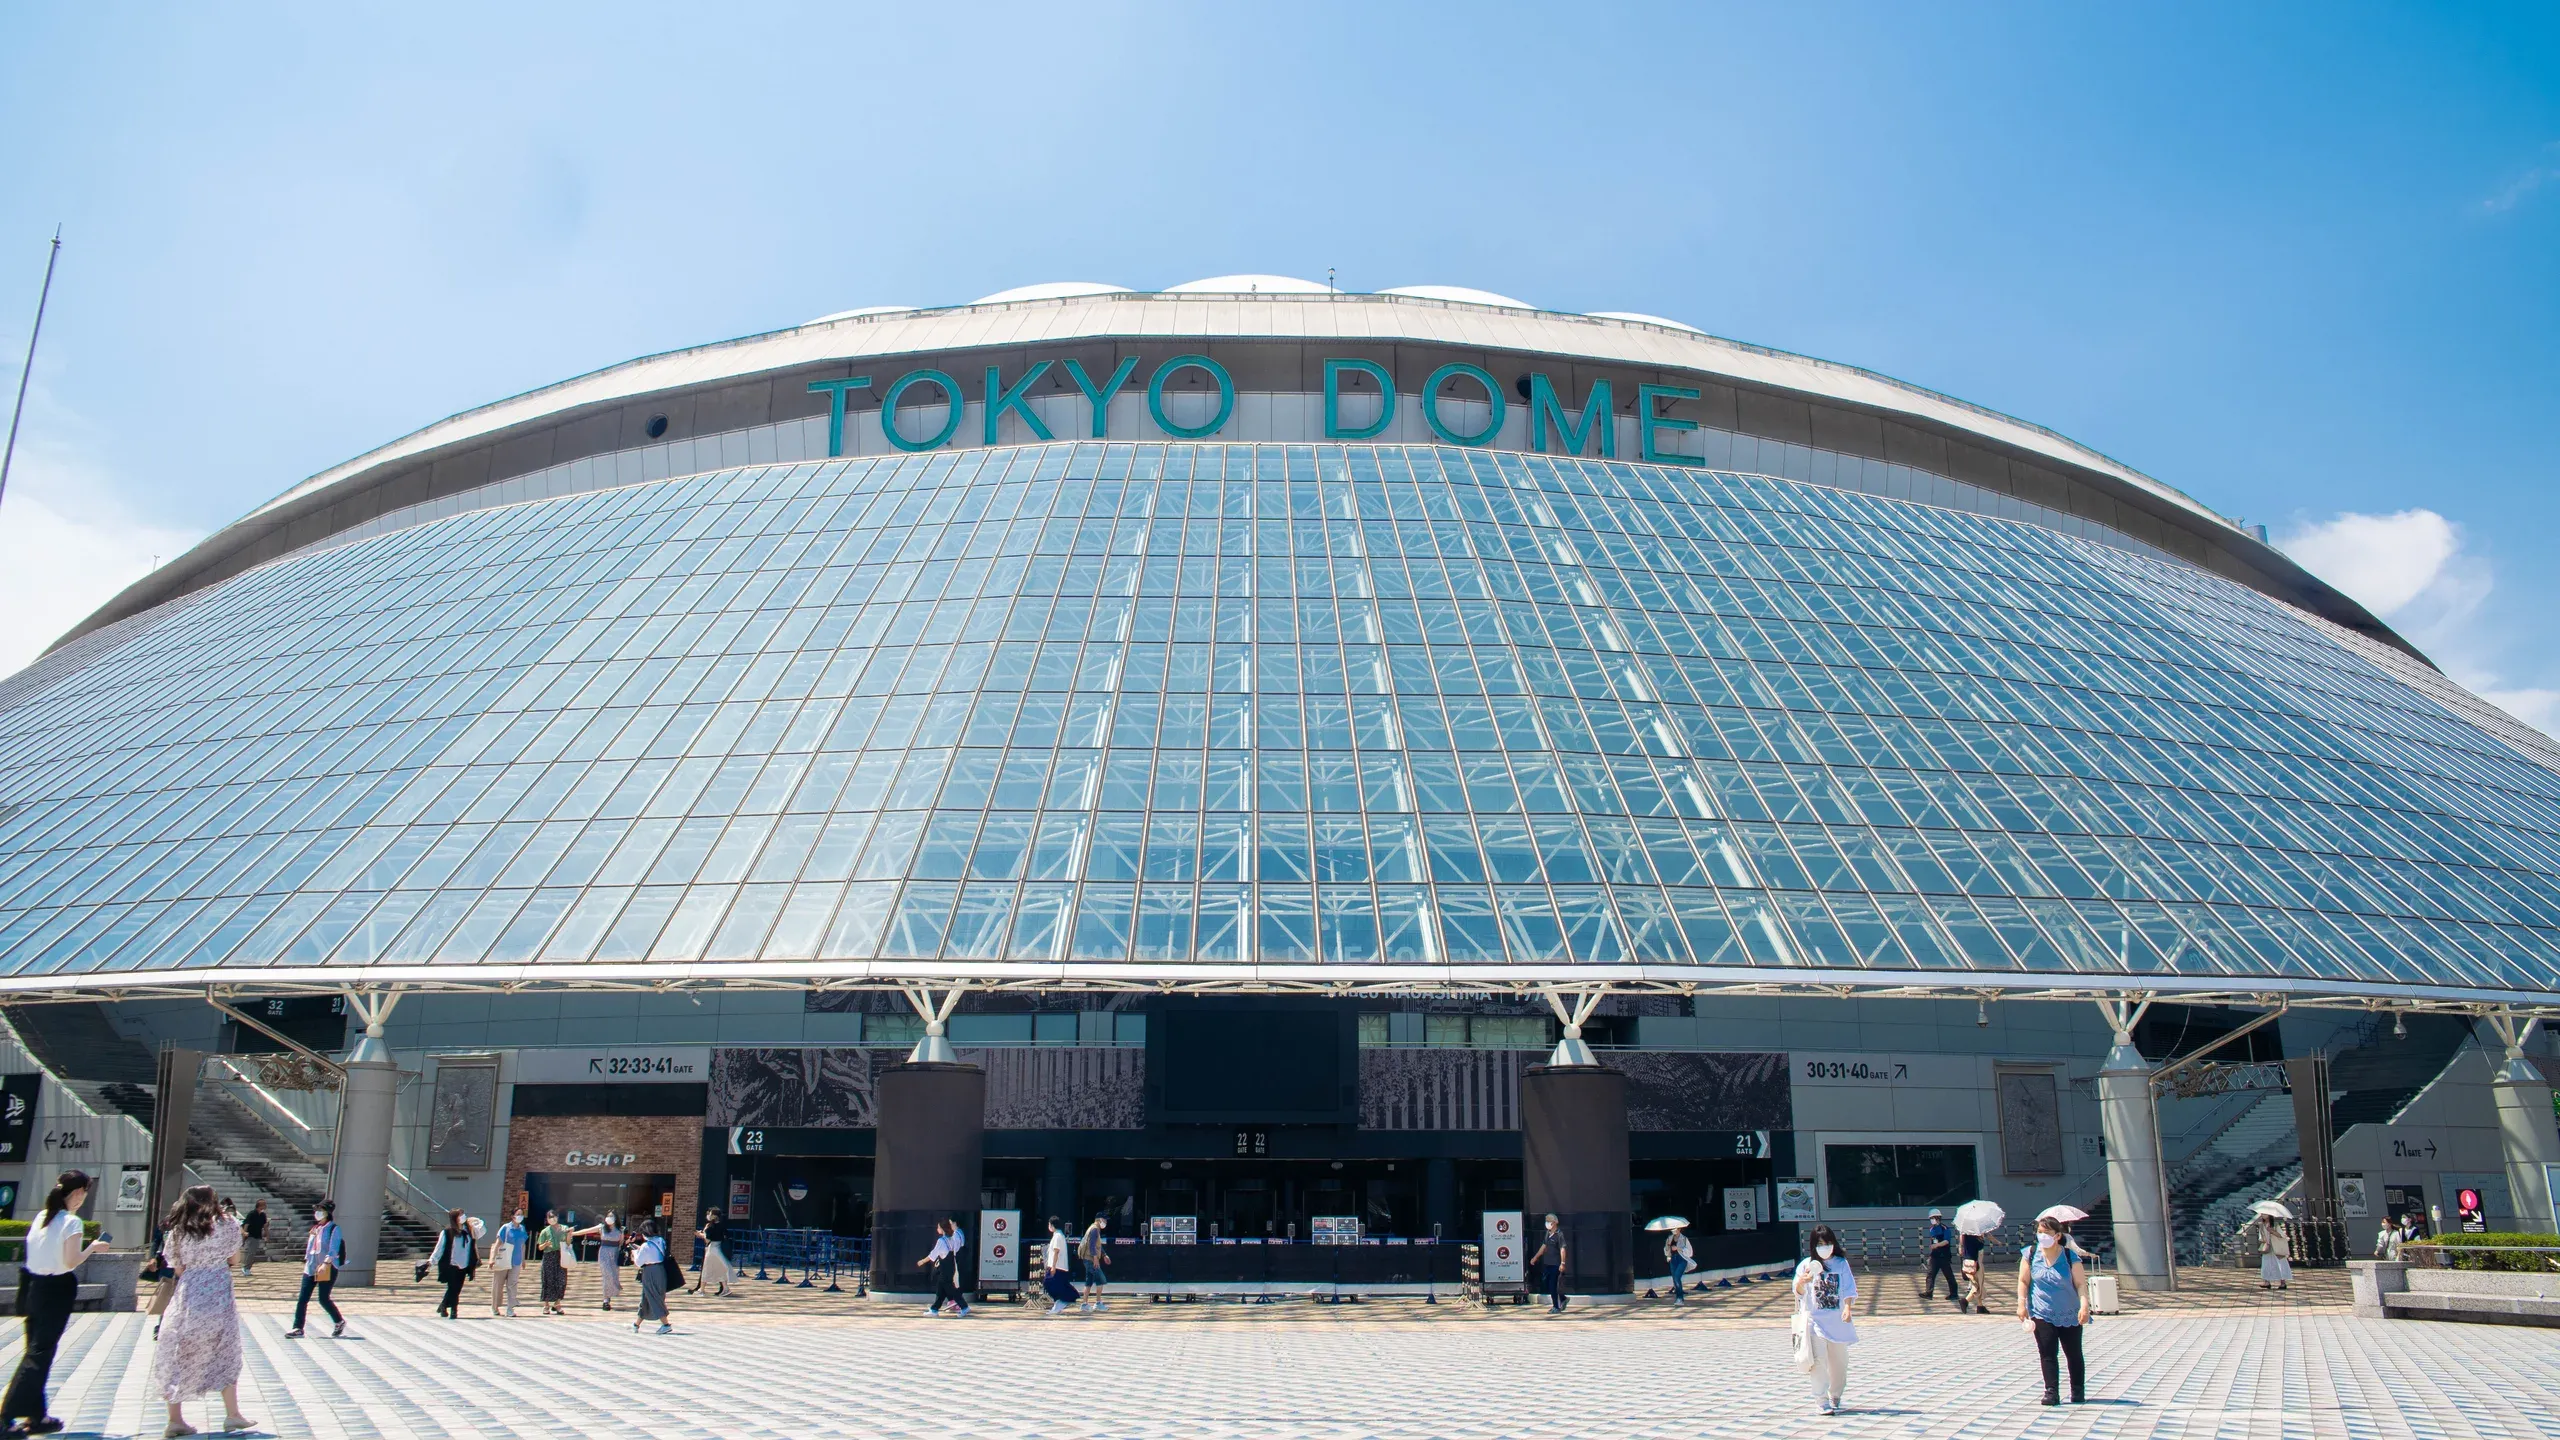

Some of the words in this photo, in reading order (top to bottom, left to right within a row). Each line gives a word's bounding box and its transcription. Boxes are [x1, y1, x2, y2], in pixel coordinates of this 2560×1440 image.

[807, 354, 1235, 458] TOKYO
[1324, 358, 1706, 466] DOME
[268, 1000, 284, 1010] 32
[673, 1065, 694, 1074] GATE
[1869, 1071, 1889, 1080] GATE
[60, 1132, 77, 1149] 23
[75, 1141, 91, 1149] GATE
[746, 1131, 764, 1144] 23
[1237, 1133, 1248, 1146] 22
[1255, 1133, 1265, 1146] 22
[1736, 1135, 1752, 1148] 21
[2394, 1140, 2408, 1157] 21
[2407, 1149, 2422, 1157] GATE
